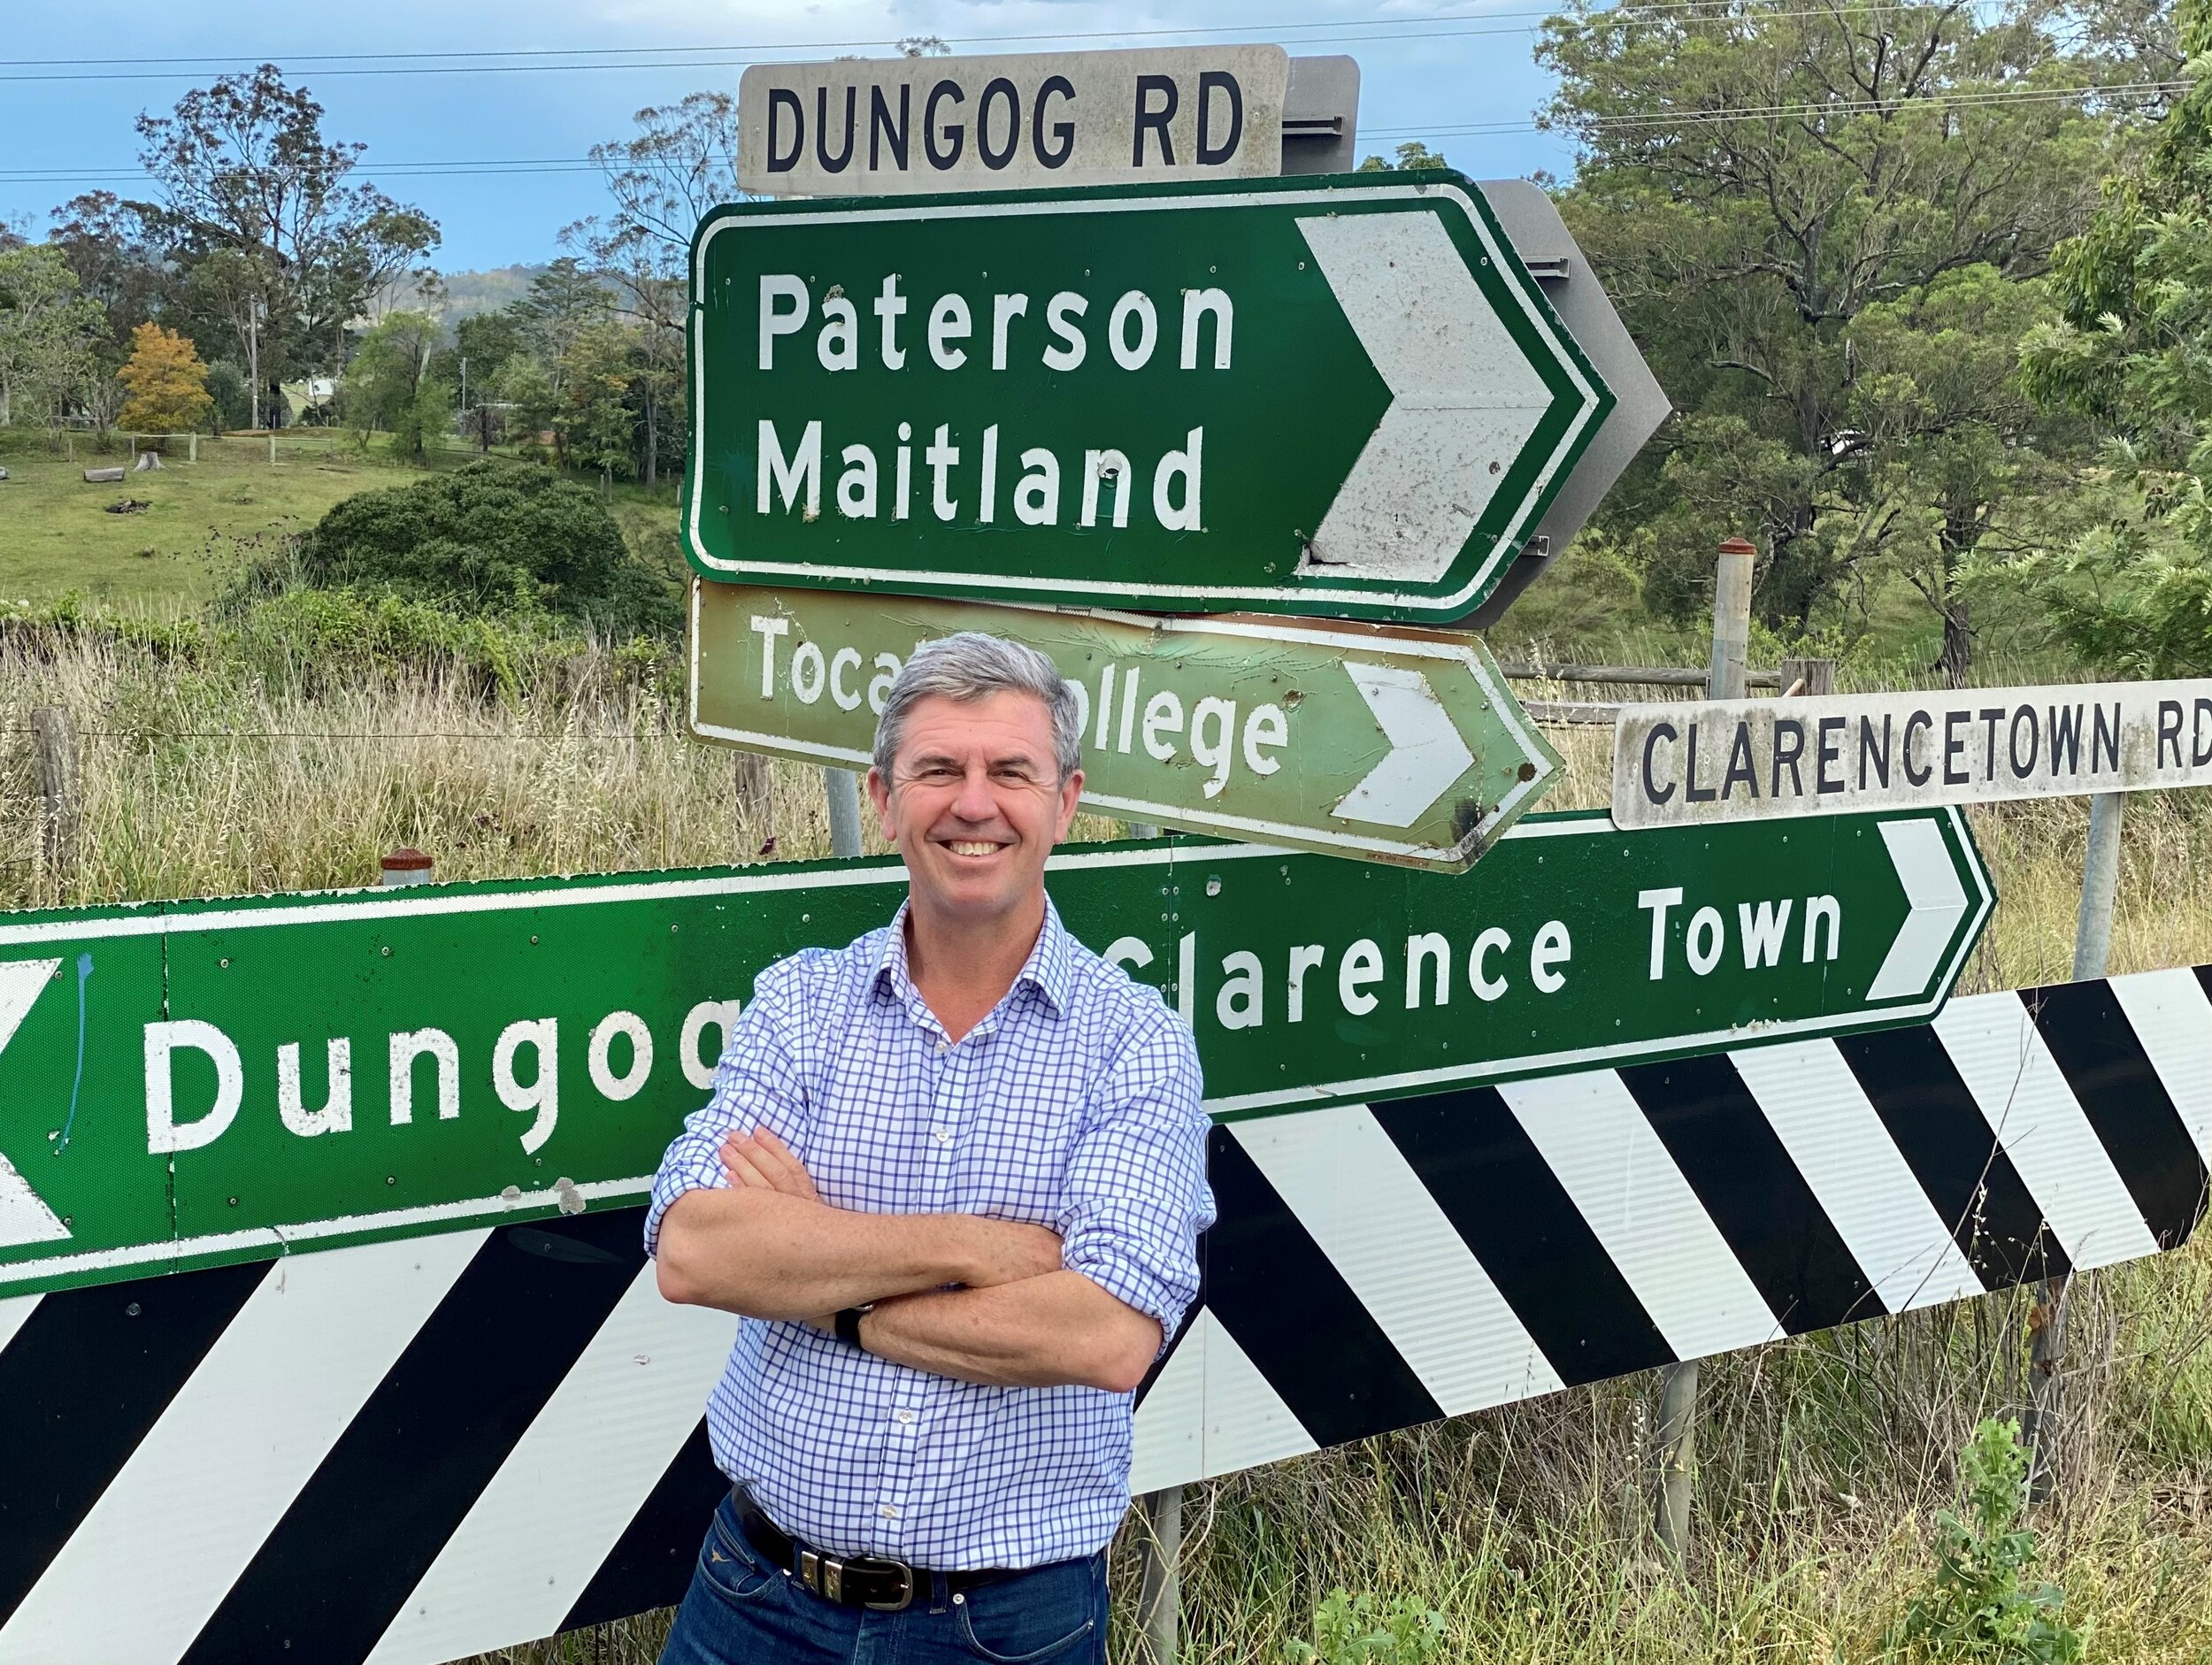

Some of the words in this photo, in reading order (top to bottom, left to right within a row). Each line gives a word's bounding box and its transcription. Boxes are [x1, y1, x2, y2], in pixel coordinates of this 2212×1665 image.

[766, 75, 1077, 173] DUNGOG
[1133, 71, 1243, 168] RD
[758, 272, 1234, 372] Paterson
[756, 420, 1202, 532] Maitland
[750, 614, 934, 717] Toca
[1641, 702, 2122, 805] CLARENCETOWN
[2157, 697, 2212, 770] RD
[1638, 886, 1841, 980] Town
